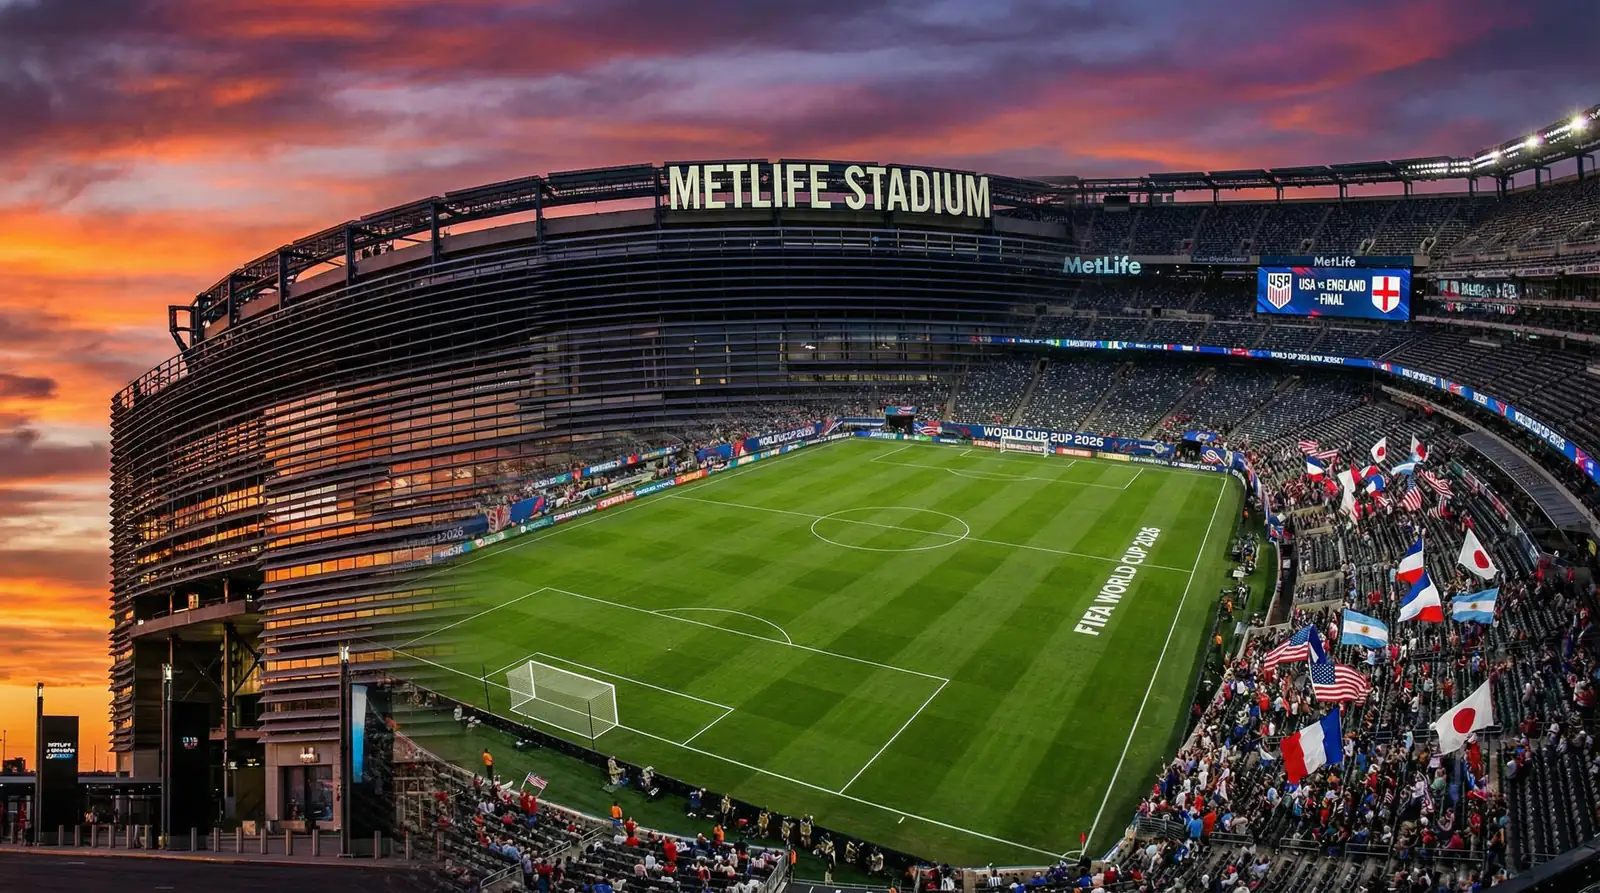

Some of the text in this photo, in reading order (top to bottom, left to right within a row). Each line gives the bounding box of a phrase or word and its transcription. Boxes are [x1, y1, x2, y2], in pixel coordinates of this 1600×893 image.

[669, 163, 990, 218] METLIFE STADIUM
[1063, 256, 1141, 275] MetLife
[1314, 256, 1356, 267] MetLife
[1269, 274, 1290, 289] USA
[1299, 278, 1316, 290] USA
[1326, 279, 1366, 292] ENGLAND
[1319, 293, 1344, 306] FINAL
[984, 426, 1023, 439] WORLD
[1023, 430, 1049, 440] CUP
[1074, 434, 1104, 447] 2026
[1073, 526, 1161, 636] FIFA WORLD CUP 2026
